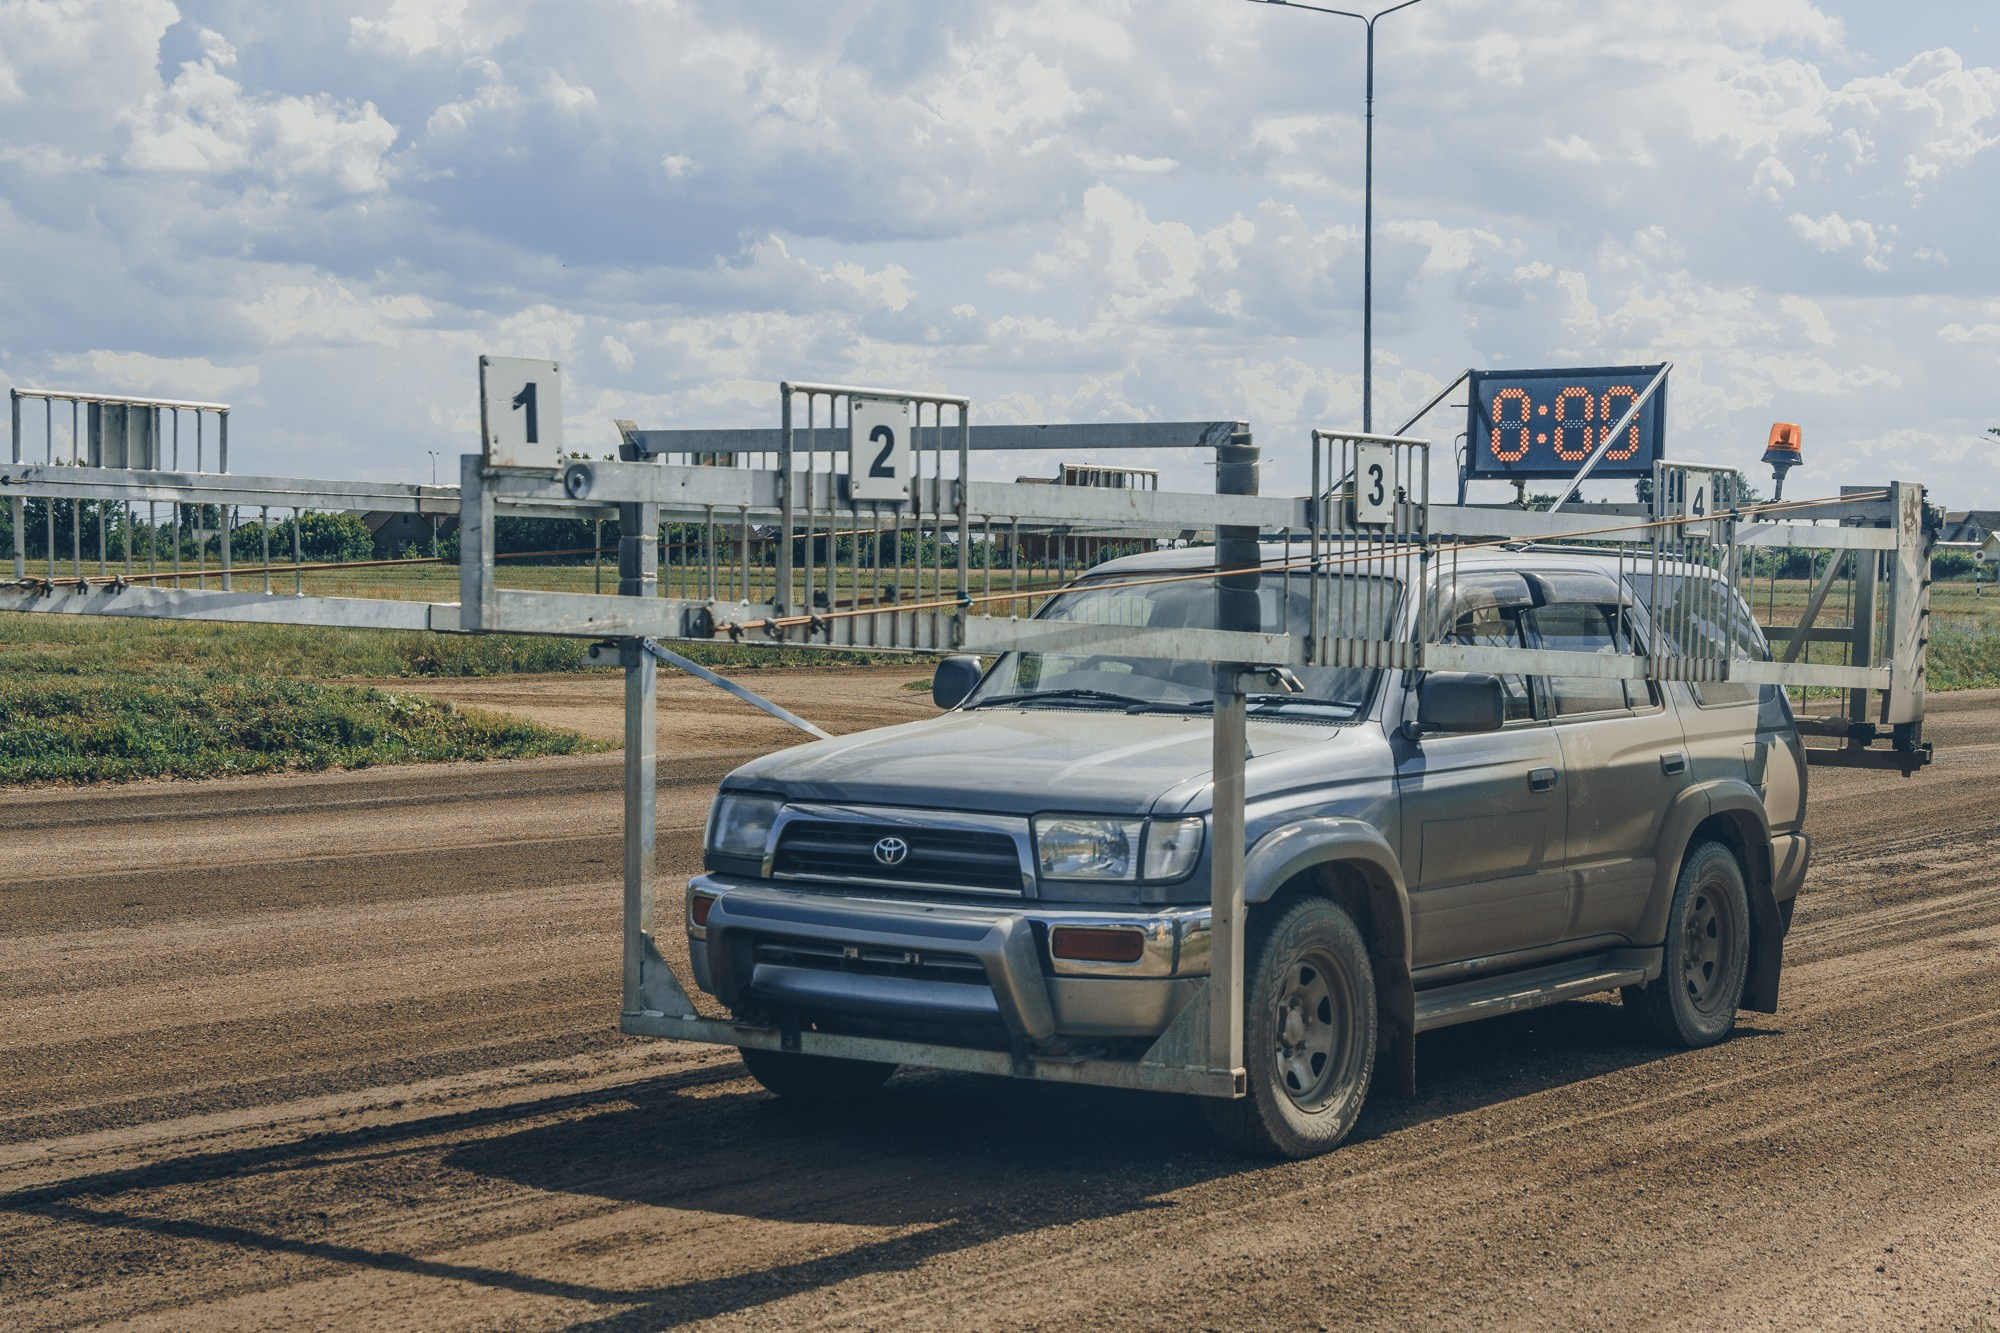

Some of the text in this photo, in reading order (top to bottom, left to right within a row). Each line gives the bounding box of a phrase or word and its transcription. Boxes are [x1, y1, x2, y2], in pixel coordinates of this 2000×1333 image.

[512, 382, 539, 444] 1
[1491, 385, 1640, 461] 0:00
[869, 424, 895, 478] 2
[1367, 463, 1384, 506] 3
[1692, 486, 1705, 521] 4
